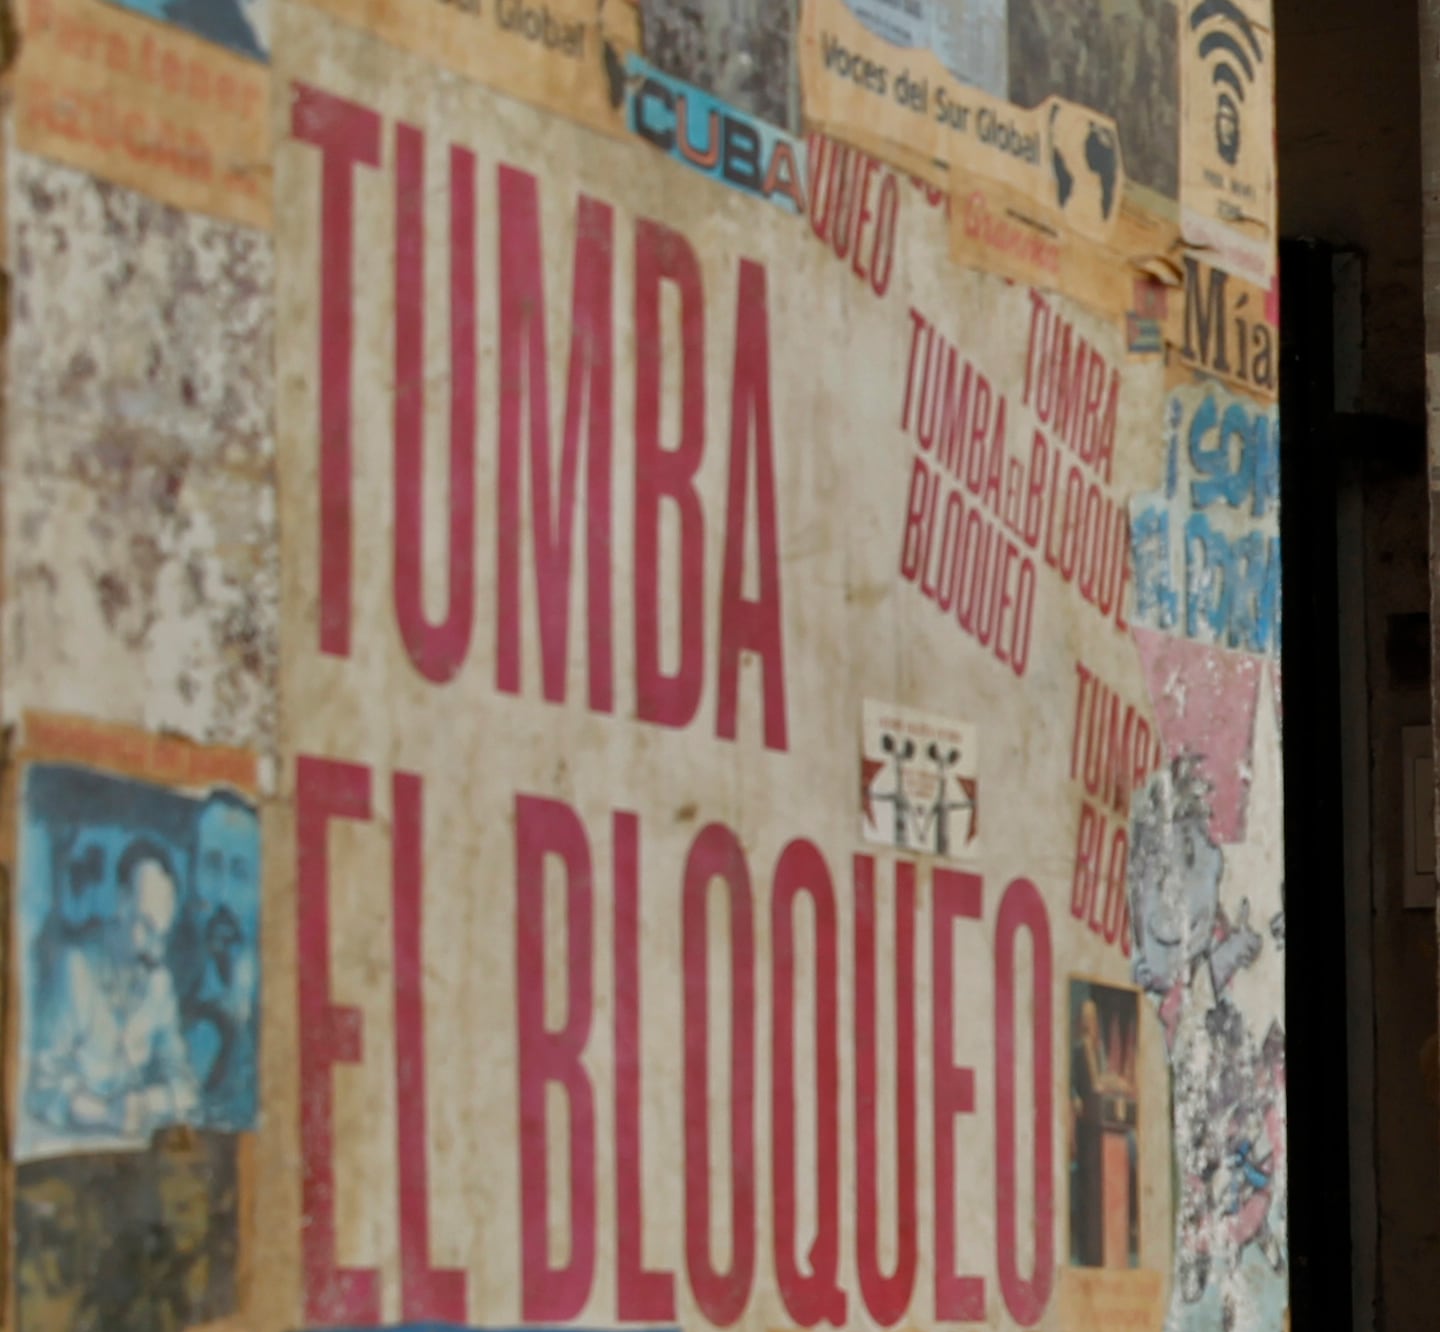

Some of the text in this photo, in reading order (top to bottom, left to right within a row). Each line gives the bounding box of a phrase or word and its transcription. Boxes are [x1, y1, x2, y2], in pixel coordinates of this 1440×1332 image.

[633, 78, 803, 213] CUBA
[822, 30, 1042, 166] Voces del Sur Global
[1182, 252, 1276, 391] Mía
[289, 80, 788, 753] TUMBA
[900, 455, 1037, 678] BLOQUEO
[295, 753, 1053, 1328] EL BLOQUEO
